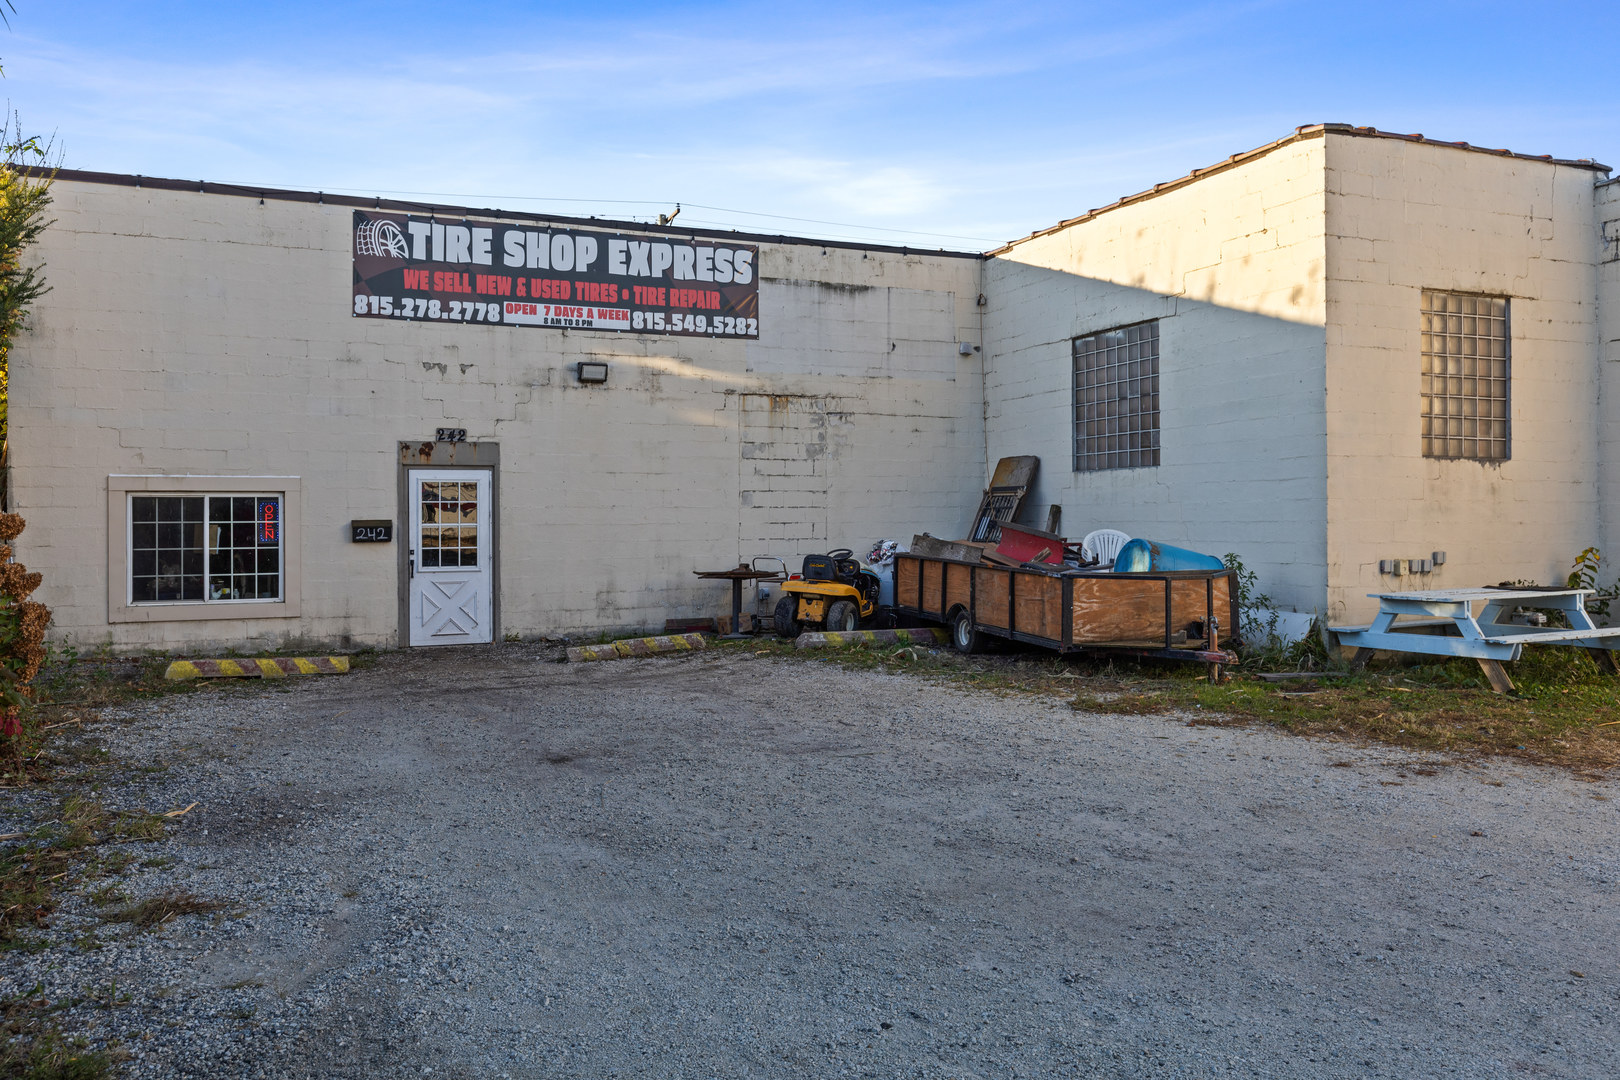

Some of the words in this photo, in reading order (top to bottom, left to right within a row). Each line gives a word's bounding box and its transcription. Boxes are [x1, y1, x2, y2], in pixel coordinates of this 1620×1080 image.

[408, 221, 493, 266] TIRE
[503, 230, 598, 273] SHOP
[608, 239, 753, 285] EXPRESS
[403, 269, 429, 291] WE
[433, 271, 472, 294] SELL
[476, 274, 512, 296] NEW
[516, 277, 527, 297] &
[531, 278, 571, 300] USED
[575, 281, 618, 303] TIRES
[633, 285, 666, 307] TIRE
[669, 288, 721, 310] REPAIR
[354, 294, 500, 323] 815.278.2778
[505, 303, 538, 316] OPEN
[544, 305, 551, 316] 7
[554, 306, 584, 319] DAYS
[586, 308, 595, 319] A
[597, 309, 630, 321] WEEK
[544, 317, 549, 325] 8
[550, 318, 563, 326] AM
[564, 318, 574, 326] TO
[575, 319, 580, 327] 8
[581, 319, 593, 327] PM
[632, 311, 758, 336] 815.549.5282
[437, 428, 466, 442] 242
[264, 504, 274, 540] OPEN
[355, 527, 389, 541] 242
